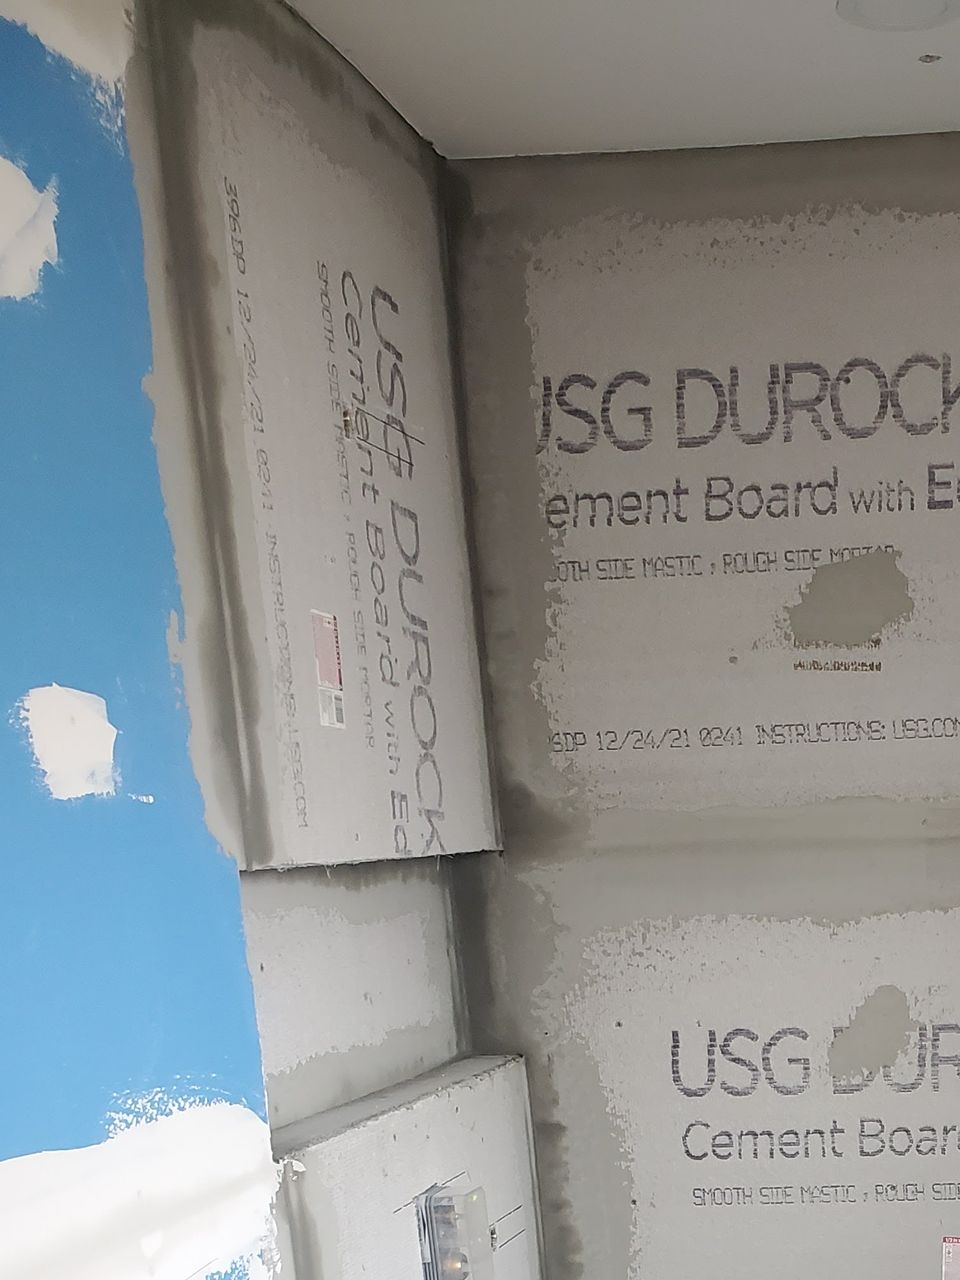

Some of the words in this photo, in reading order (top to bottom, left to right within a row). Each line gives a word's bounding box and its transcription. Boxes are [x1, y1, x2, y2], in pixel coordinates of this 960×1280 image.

[316, 260, 336, 354] SMOOTH
[327, 361, 342, 413] SIDE
[353, 609, 367, 657] SIDE
[544, 477, 690, 529] ement
[705, 465, 838, 521] Board
[850, 479, 916, 514] with
[341, 270, 380, 505] Cement
[366, 518, 400, 688] Board
[384, 701, 402, 777] with
[596, 557, 635, 580] SIDE
[642, 554, 702, 578] MASTIC
[722, 551, 777, 574] ROUGH
[596, 727, 691, 750] 12/24/21
[671, 1027, 810, 1098] USG
[682, 1119, 846, 1160] Cement
[692, 1187, 752, 1206] SMOOTH
[760, 1186, 794, 1205] SIDE
[800, 1185, 856, 1203] MASTIC
[875, 1183, 925, 1201] ROUGH
